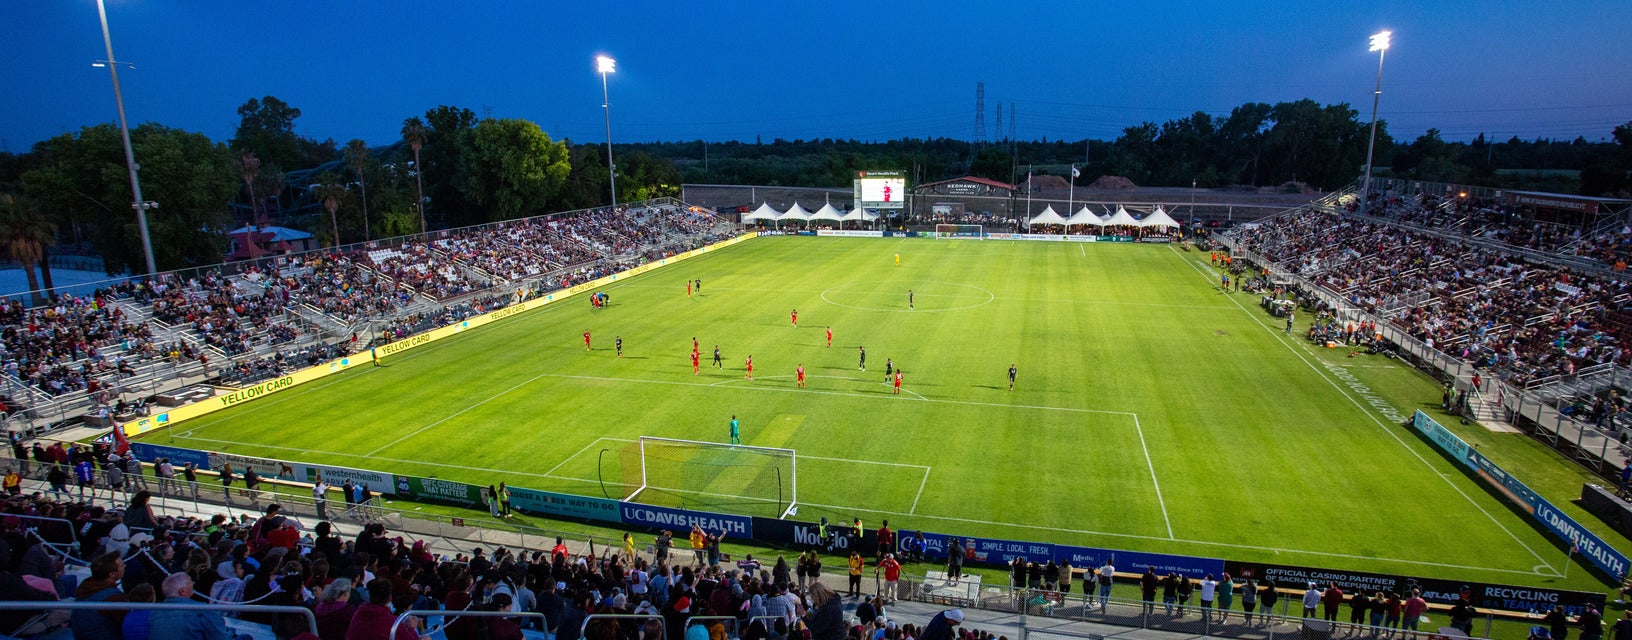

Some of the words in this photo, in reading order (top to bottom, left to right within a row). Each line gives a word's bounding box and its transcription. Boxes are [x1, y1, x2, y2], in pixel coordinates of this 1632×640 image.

[491, 308, 511, 320] YELLOW
[512, 304, 526, 314] CARD
[382, 338, 410, 354] YELLOW
[411, 334, 430, 346] CARD
[221, 384, 264, 406] YELLOW
[266, 376, 293, 392] CARD
[424, 486, 439, 494] THAT
[440, 488, 468, 498] MATTERS
[438, 482, 468, 491] COVERAGE
[568, 500, 585, 508] WAY
[688, 516, 745, 533] HEALTH
[900, 536, 943, 551] CTAL
[1072, 554, 1094, 562] Medic
[1580, 534, 1624, 573] HEALTH
[1266, 568, 1308, 578] OFFICIAL
[1310, 572, 1346, 581] CASINO
[1350, 575, 1396, 586] PARTNER
[1422, 591, 1460, 601] ATLAS
[1485, 587, 1559, 602] RECYCLING
[1502, 600, 1538, 612] TEAM
